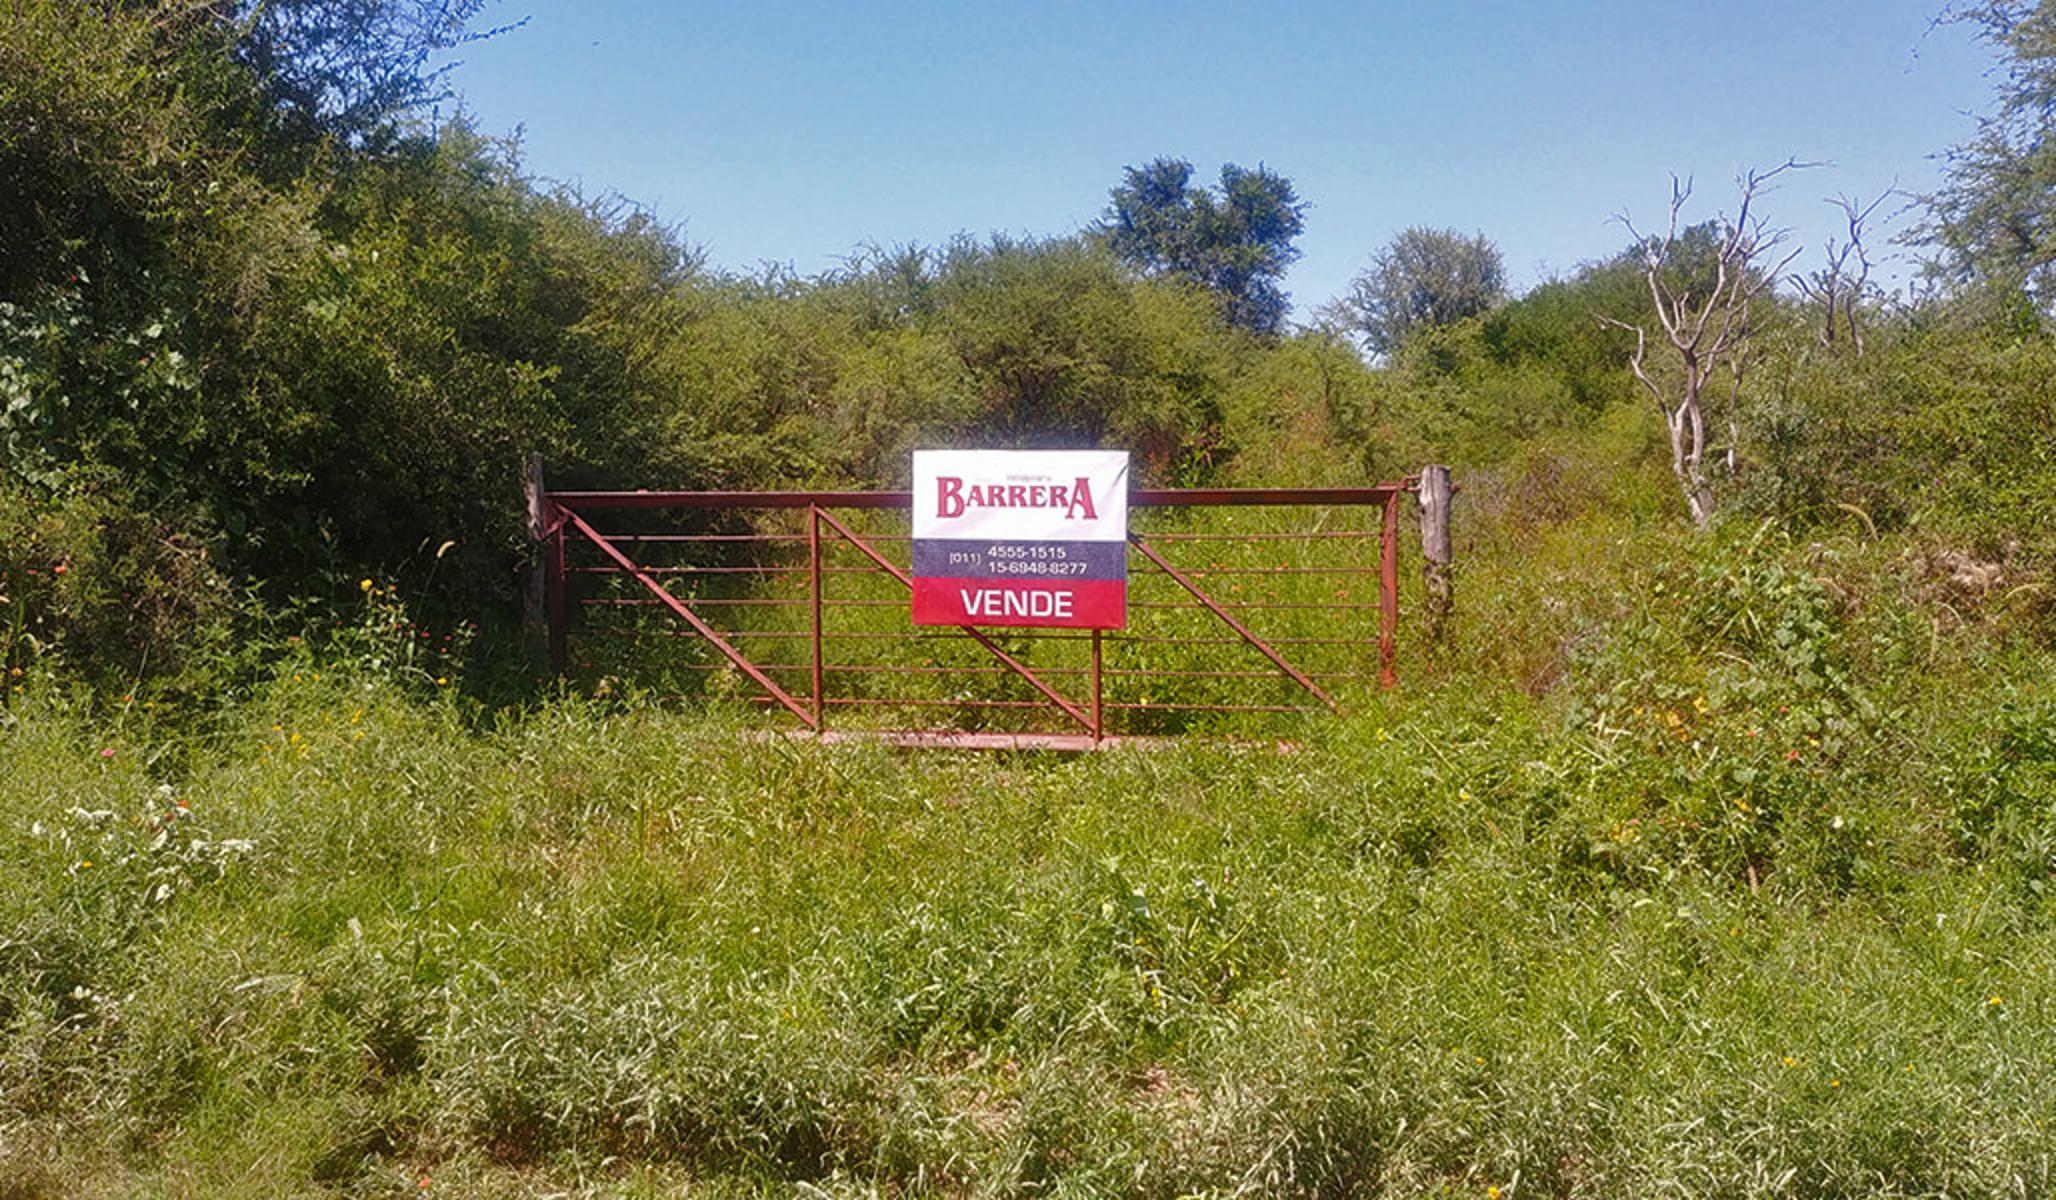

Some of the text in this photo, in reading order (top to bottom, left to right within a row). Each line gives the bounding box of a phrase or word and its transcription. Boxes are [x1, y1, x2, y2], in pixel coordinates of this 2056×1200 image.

[936, 476, 1098, 519] BARRERA
[987, 545, 1067, 560] 4555-1515
[960, 588, 1073, 617] VENDE
